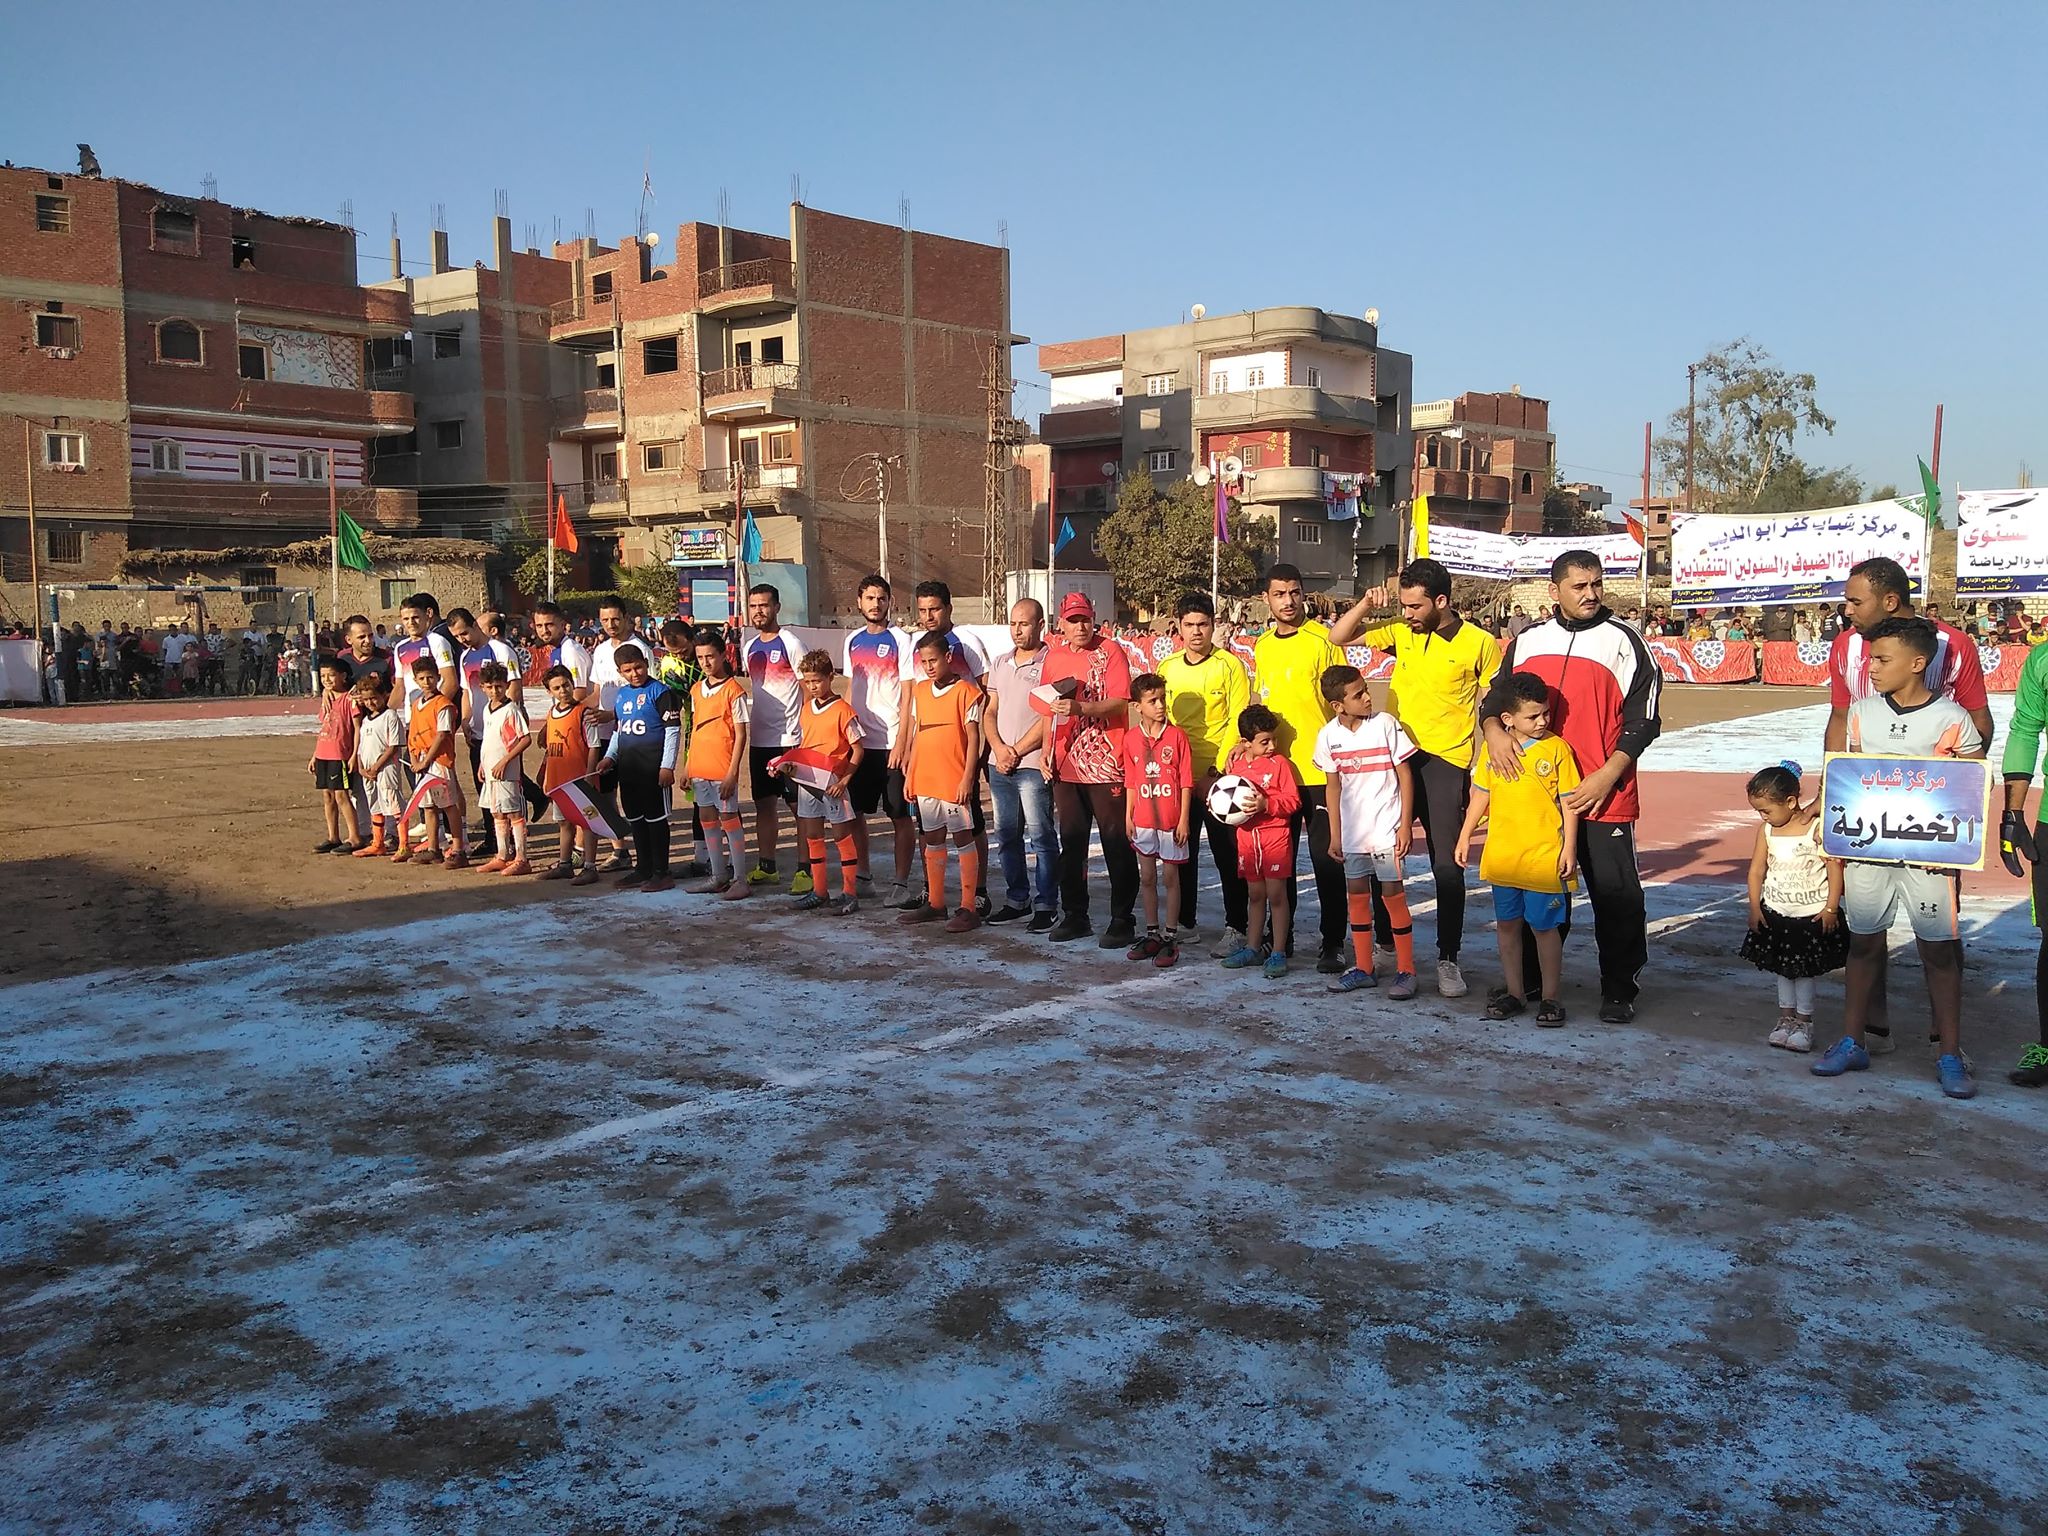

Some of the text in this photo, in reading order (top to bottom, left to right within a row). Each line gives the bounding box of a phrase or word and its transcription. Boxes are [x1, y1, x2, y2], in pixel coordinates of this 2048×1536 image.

[1779, 516, 1810, 538] كفر
[1812, 512, 1856, 536] شباب
[1857, 515, 1898, 538] مركز
[1708, 524, 1752, 551] الديب
[1604, 552, 1640, 564] عصام
[1791, 551, 1836, 577] الضيوف
[1969, 554, 2031, 571] والرياضة
[1675, 557, 1733, 584] التنفيذيين
[1860, 768, 1947, 793] مركز شباب
[1830, 804, 1976, 849] الخضارية
[1777, 881, 1804, 890] BORN
[1783, 872, 1804, 881] WAS
[1764, 885, 1793, 904] BEST
